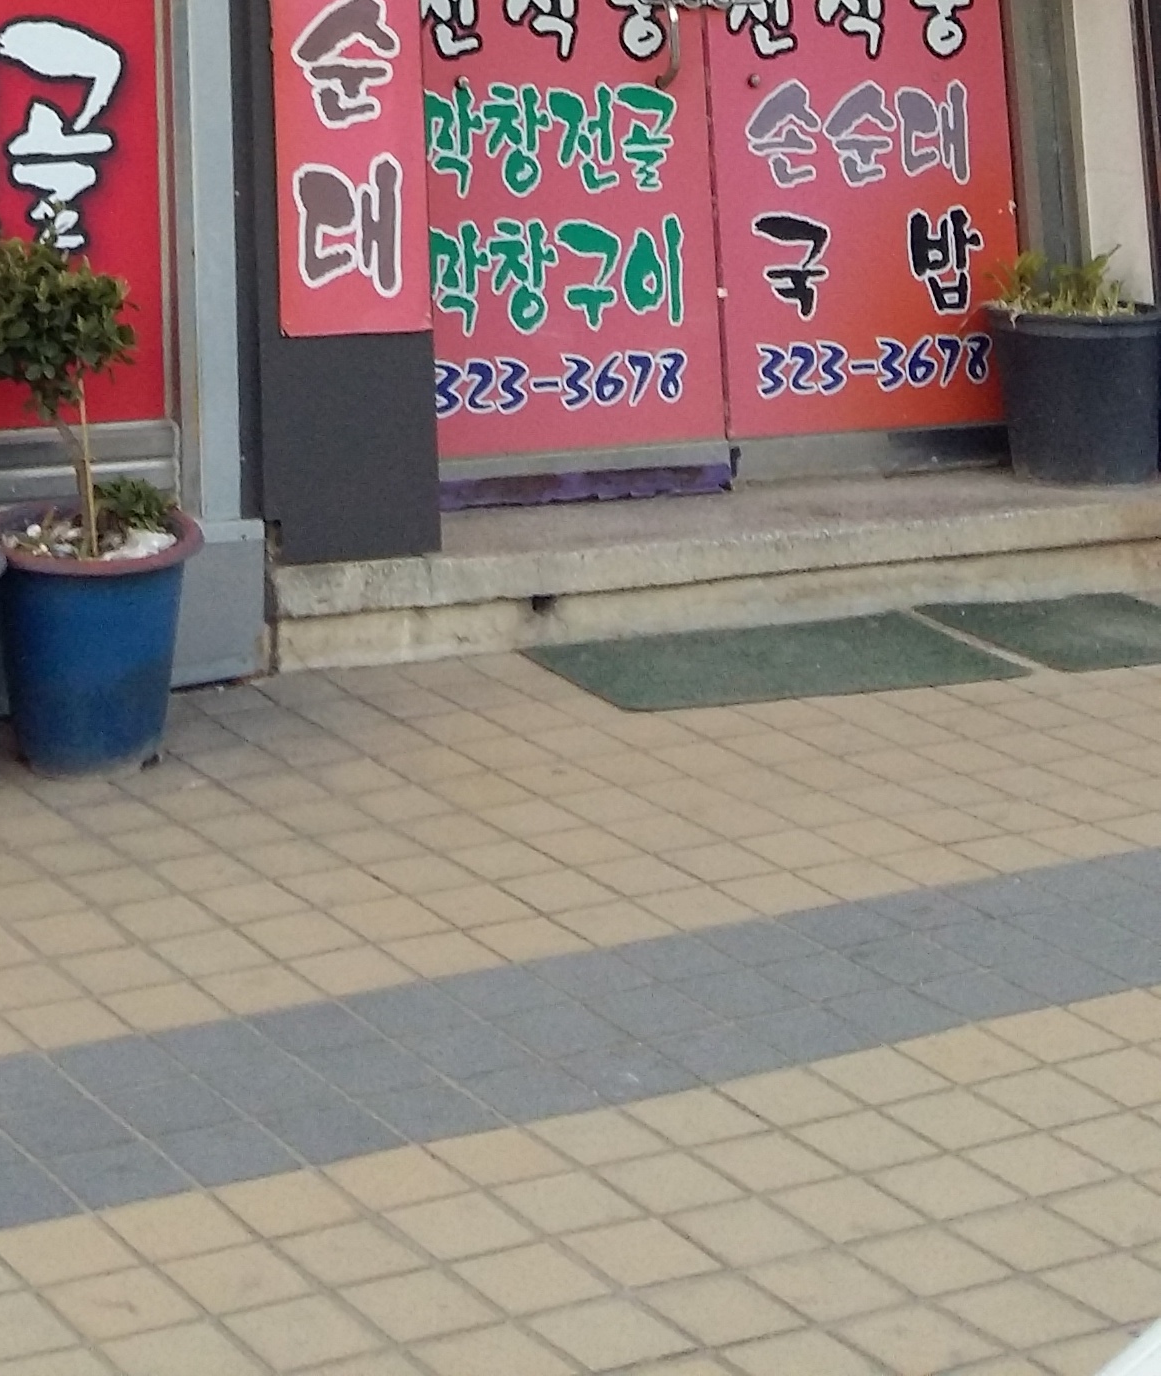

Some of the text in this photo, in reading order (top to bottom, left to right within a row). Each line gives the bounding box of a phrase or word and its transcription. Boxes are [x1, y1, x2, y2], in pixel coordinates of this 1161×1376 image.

[424, 80, 677, 199] 막창전골
[745, 78, 971, 188] 손순대
[429, 212, 685, 336] 막창구이
[435, 350, 687, 418] 323-3678
[754, 334, 993, 398] 323-3678
